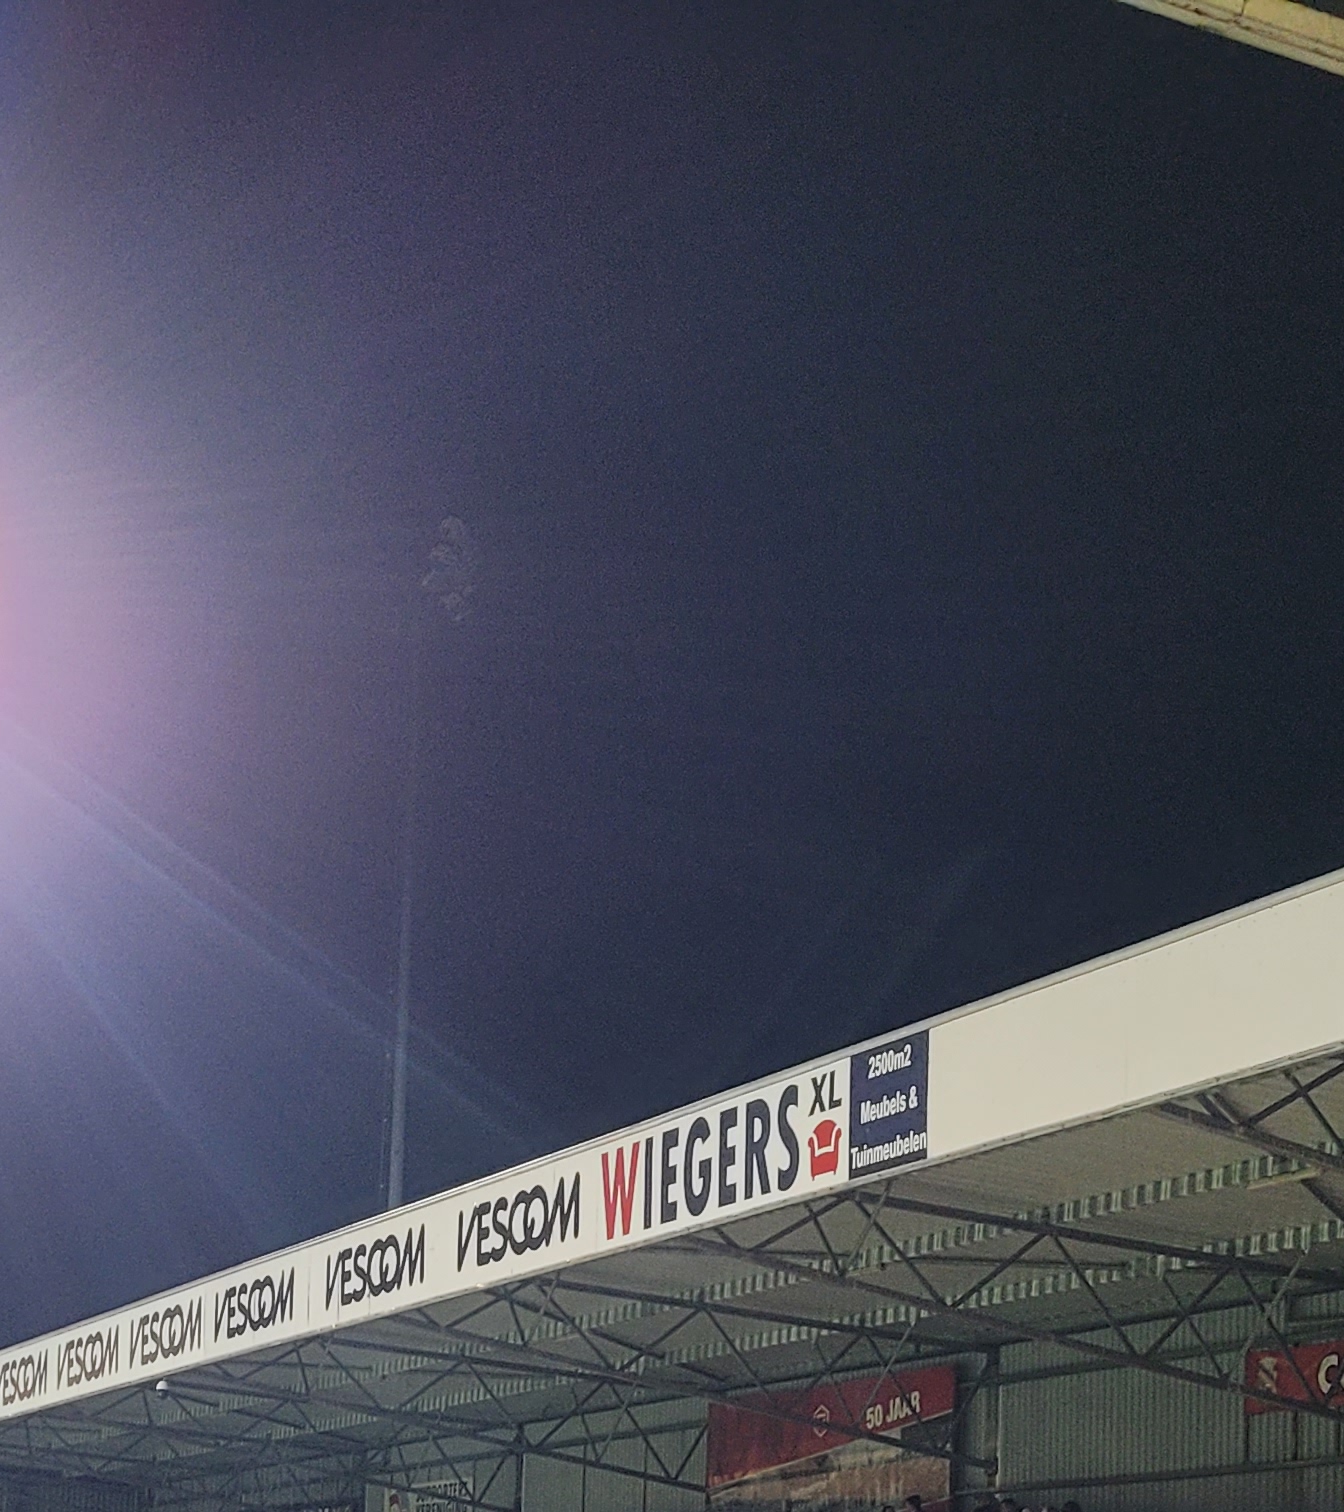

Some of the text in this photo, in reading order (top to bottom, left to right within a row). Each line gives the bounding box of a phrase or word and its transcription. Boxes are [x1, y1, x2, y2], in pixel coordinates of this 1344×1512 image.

[867, 1043, 912, 1080] 2500m2
[860, 1085, 919, 1126] Meubels &
[601, 1069, 843, 1241] WIEGERS XL
[850, 1129, 927, 1171] Tuinmeubelen
[56, 1324, 120, 1391] VESCOM
[129, 1296, 202, 1370] VESCOM
[213, 1266, 295, 1343] VESCOM
[325, 1223, 426, 1311] VESCOM
[457, 1171, 581, 1273] VESCOM
[865, 1403, 884, 1430] 50
